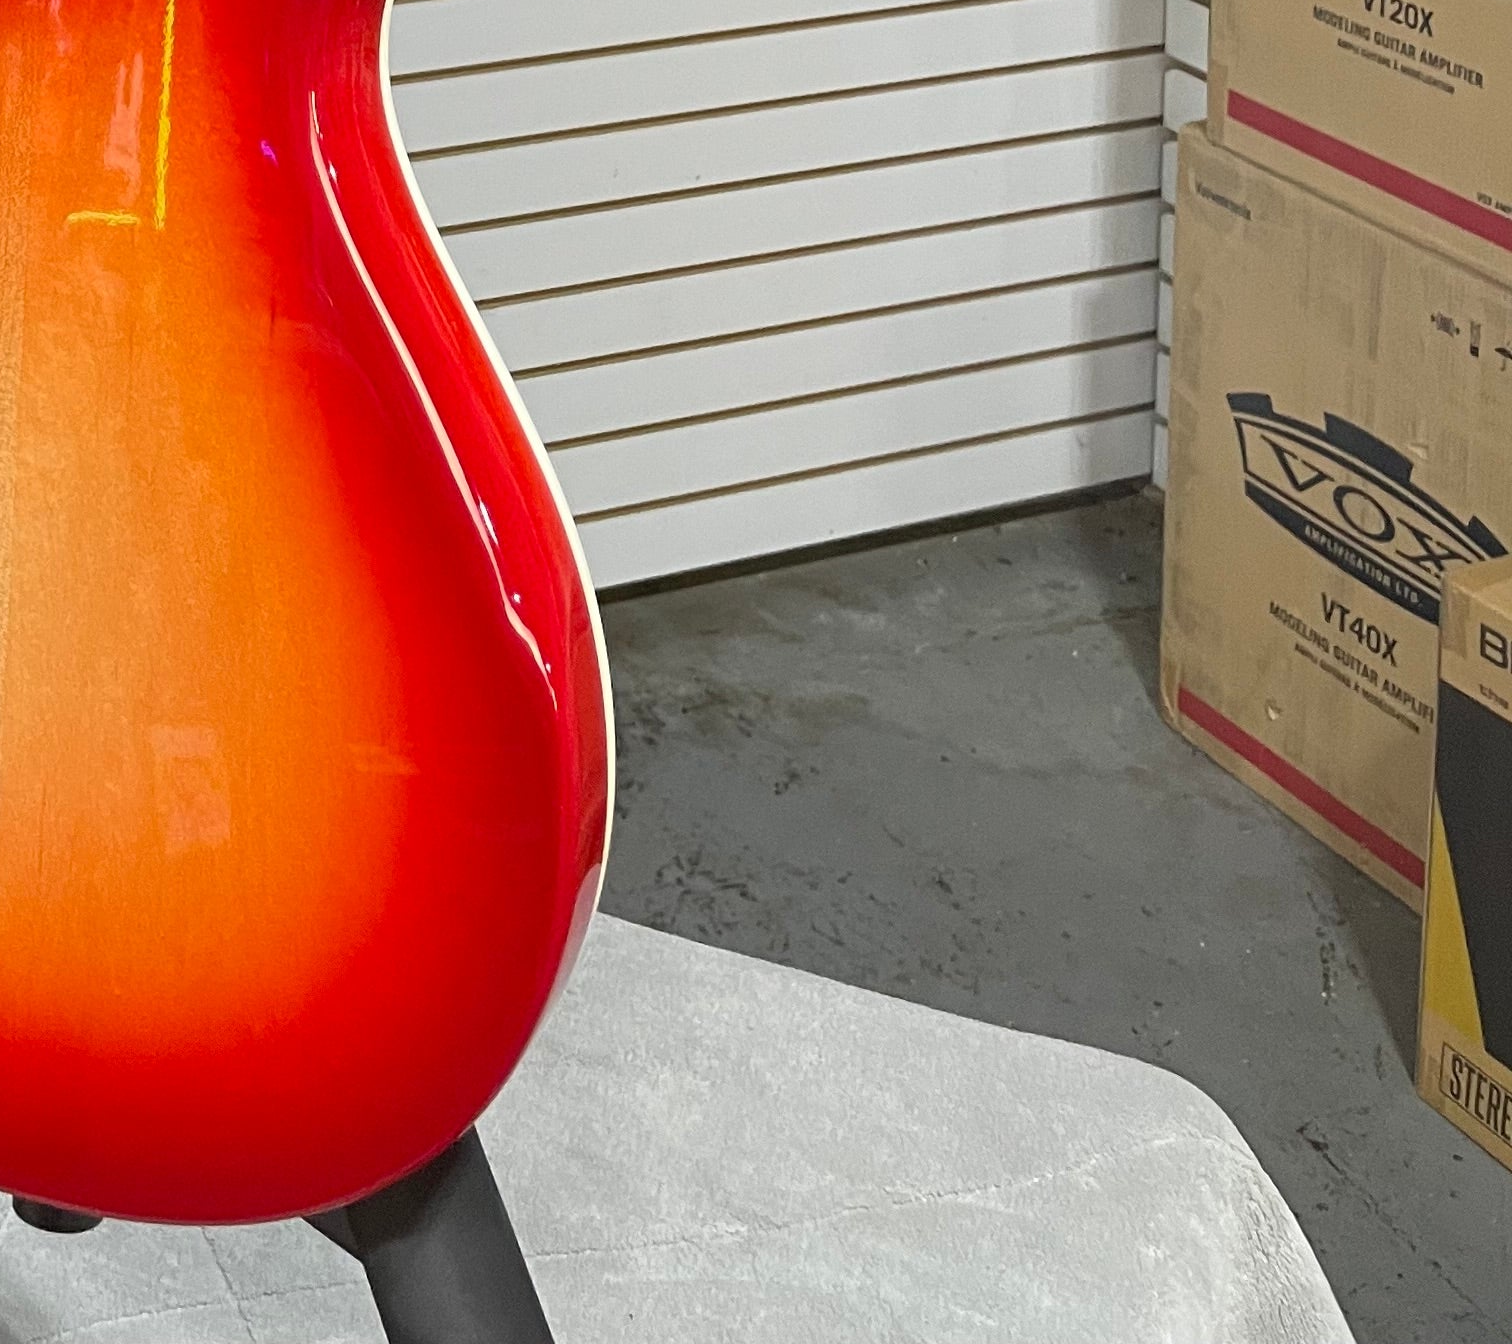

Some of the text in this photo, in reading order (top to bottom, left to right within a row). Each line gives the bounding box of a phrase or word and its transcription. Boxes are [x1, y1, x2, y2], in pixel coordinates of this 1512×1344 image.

[1313, 3, 1371, 42] MODELING
[1374, 30, 1417, 61] GUITAR
[1419, 47, 1484, 89] AMPLIFIER
[1260, 433, 1473, 580] VOX
[1304, 525, 1391, 594] AMPLIFICATION
[1269, 601, 1331, 655] MODELING
[1333, 644, 1379, 688] GUITAR
[1321, 591, 1398, 668] VT40X
